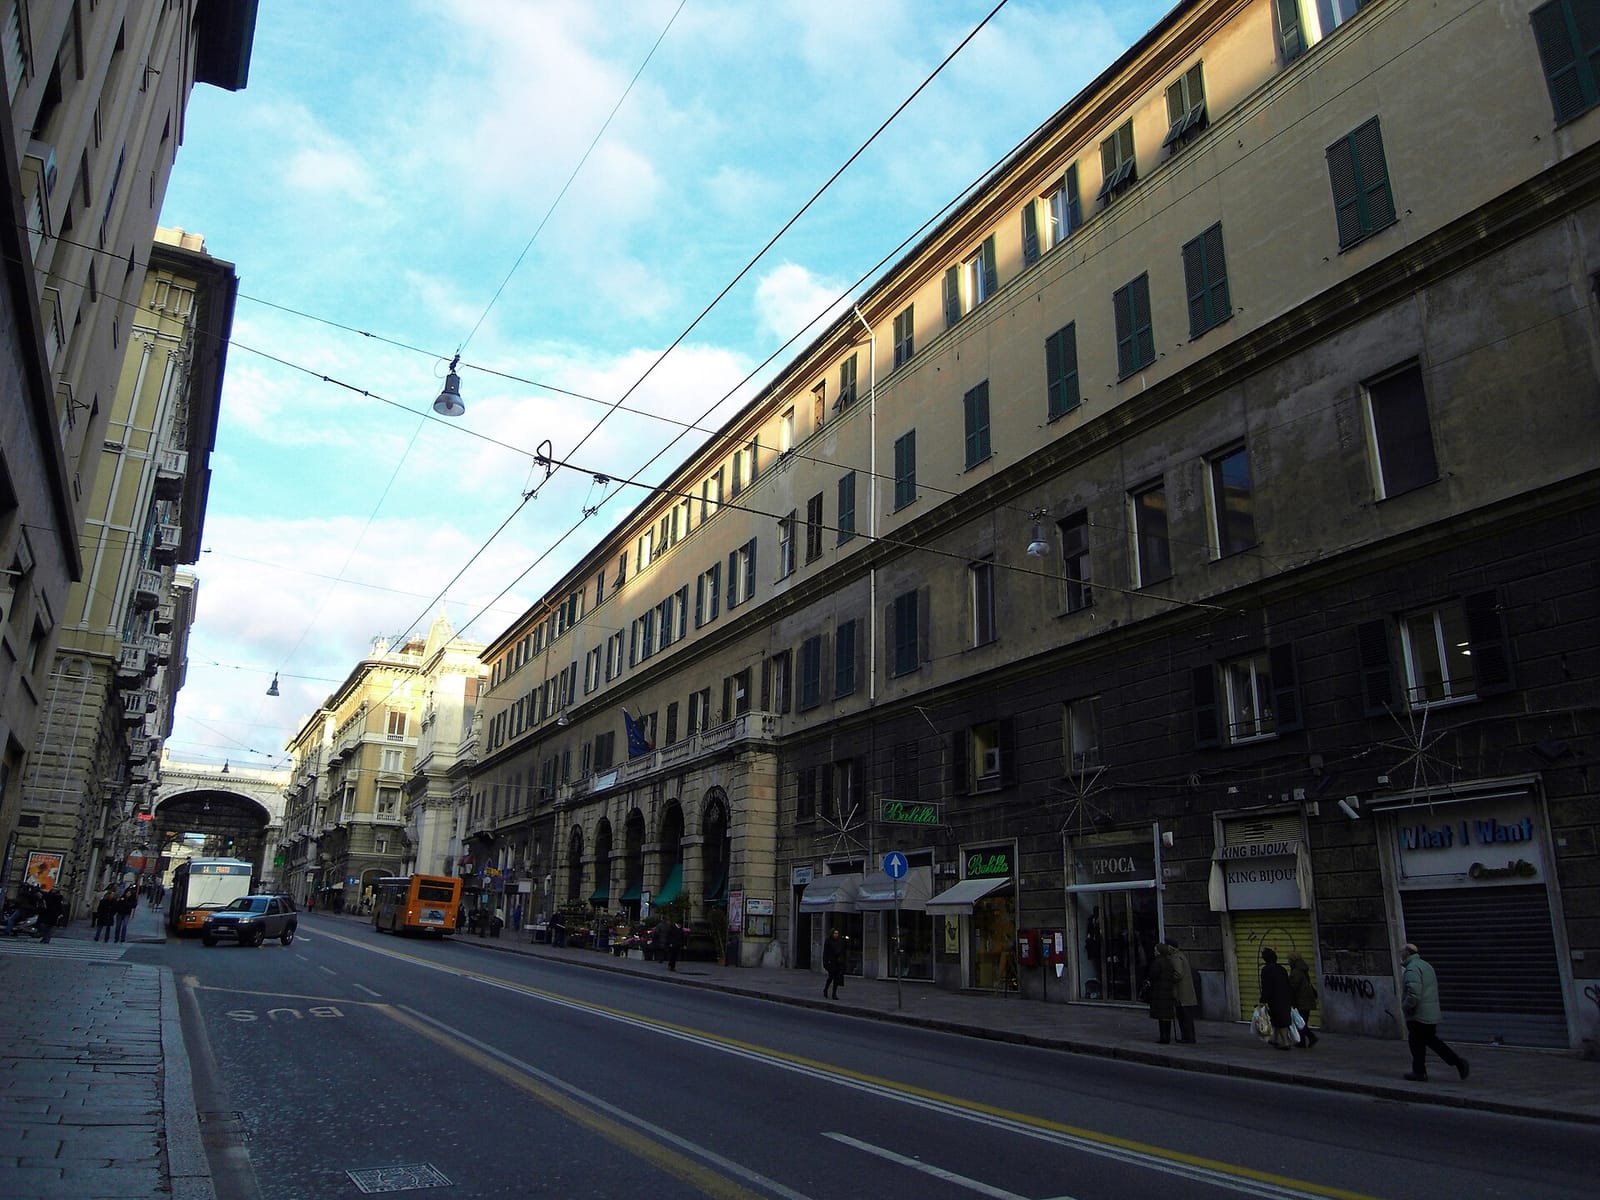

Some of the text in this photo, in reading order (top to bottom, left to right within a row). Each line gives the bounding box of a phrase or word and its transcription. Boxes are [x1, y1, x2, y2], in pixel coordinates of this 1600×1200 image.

[883, 801, 938, 824] Balilla
[1400, 817, 1533, 849] What I Want
[1222, 842, 1288, 858] KING BIJOUX
[968, 853, 1009, 875] Balilla
[1093, 857, 1136, 875] EPOCA
[1228, 868, 1296, 884] KING BIJOU
[224, 1006, 344, 1021] BUS
